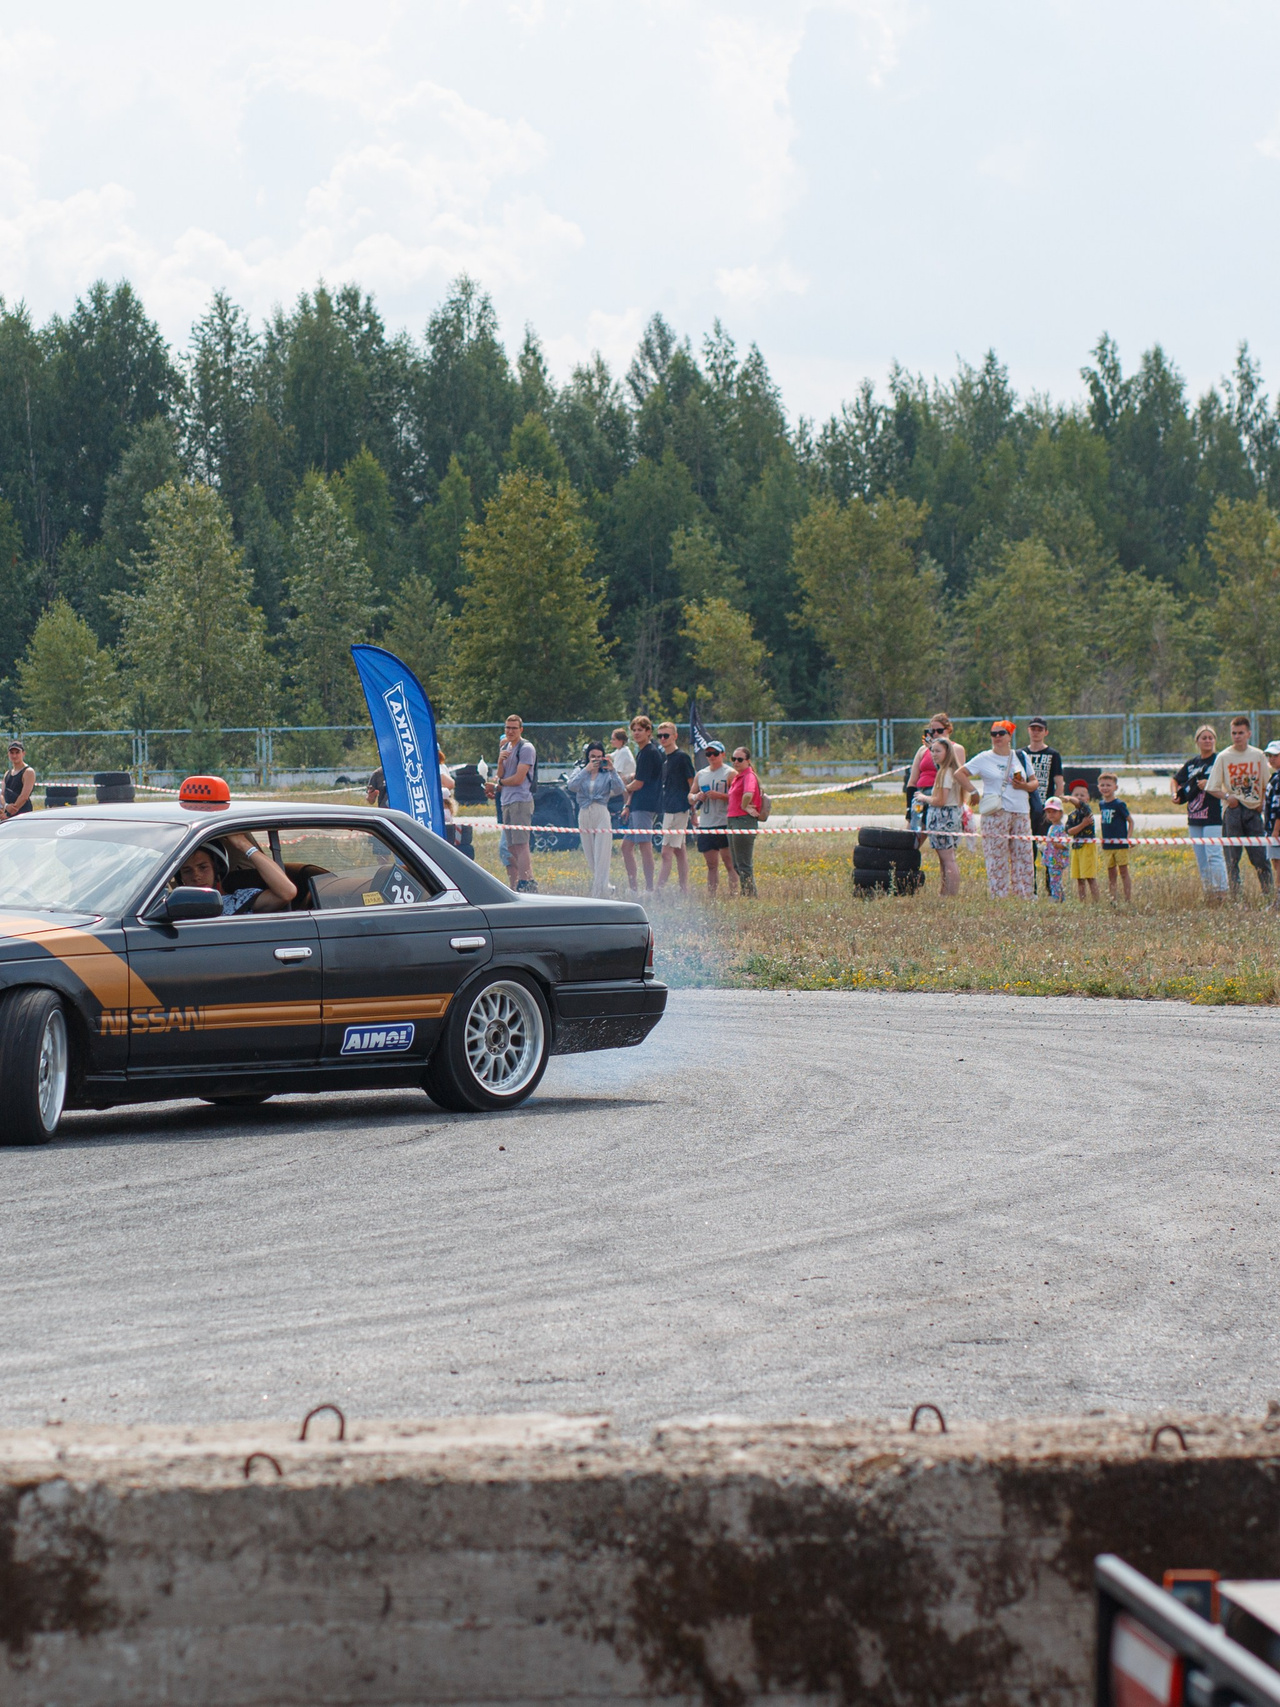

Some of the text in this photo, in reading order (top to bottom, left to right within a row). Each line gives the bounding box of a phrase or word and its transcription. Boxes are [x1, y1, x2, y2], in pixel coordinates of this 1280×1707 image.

[391, 885, 415, 904] 26
[100, 1006, 204, 1036] NISSAN
[344, 1030, 410, 1050] AIMOL
